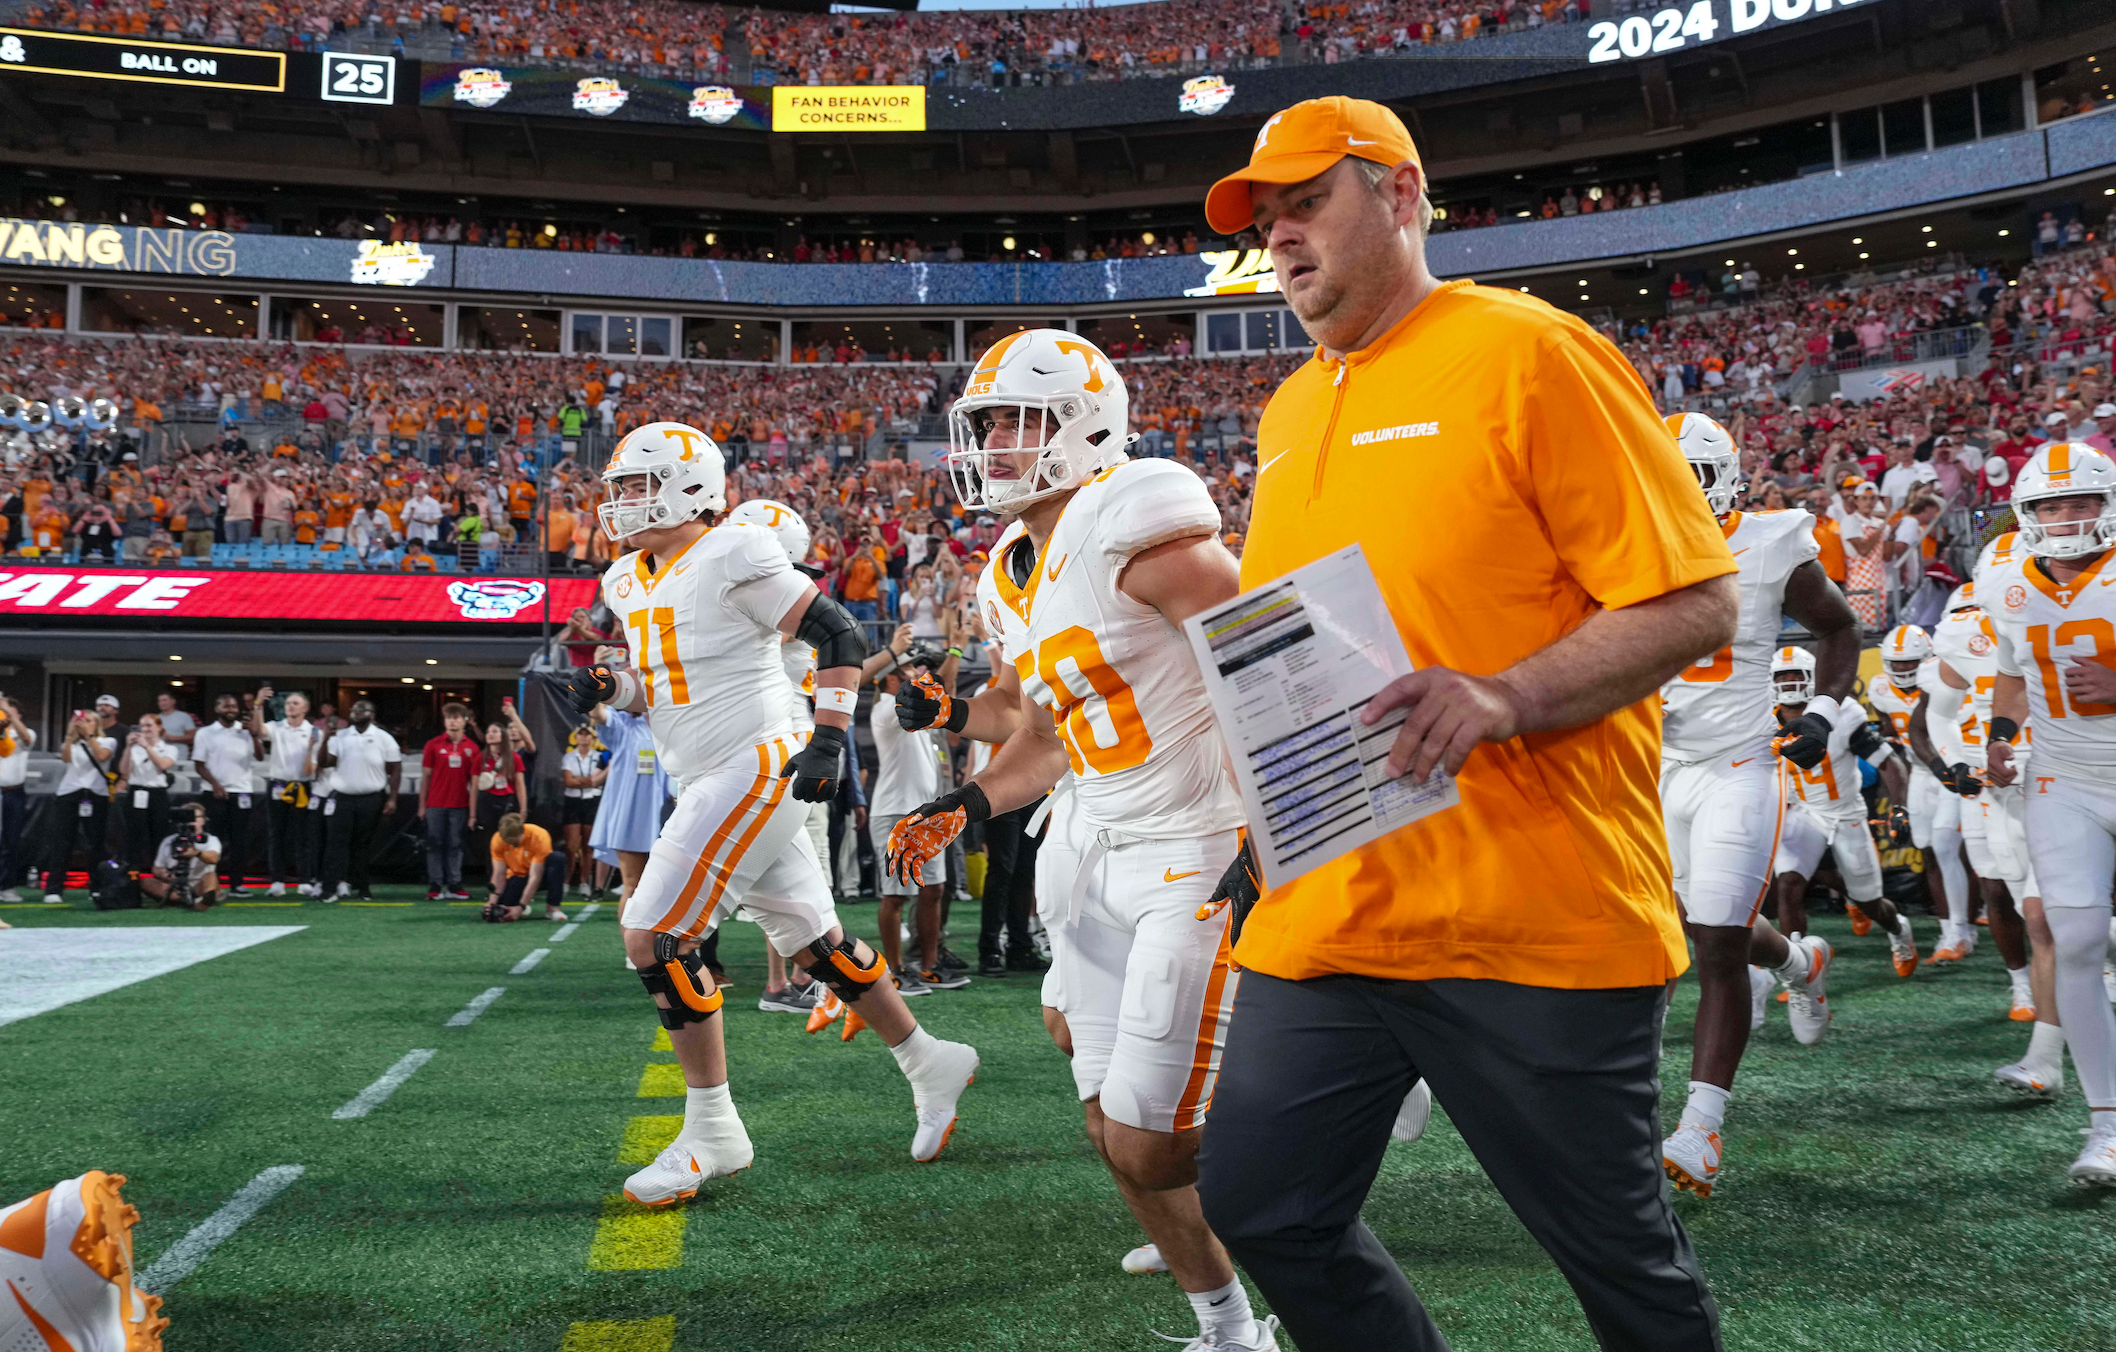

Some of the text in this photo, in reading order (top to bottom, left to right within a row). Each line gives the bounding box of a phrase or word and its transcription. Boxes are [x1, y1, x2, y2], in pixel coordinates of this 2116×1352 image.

[1588, 3, 1718, 63] 2024
[1, 35, 25, 62] &
[121, 52, 217, 76] BALL ON
[333, 62, 384, 94] 25
[791, 97, 910, 107] FAN BEHAVIOR
[800, 113, 902, 123] CONCERNS...
[966, 383, 991, 397] VOLS
[1351, 421, 1438, 446] VOLUNTEERS
[663, 430, 703, 463] T
[764, 505, 791, 528] T
[0, 573, 212, 610] ATE
[2056, 590, 2072, 605] T
[628, 607, 690, 707] 71
[835, 691, 846, 703] T
[2036, 777, 2055, 793] T
